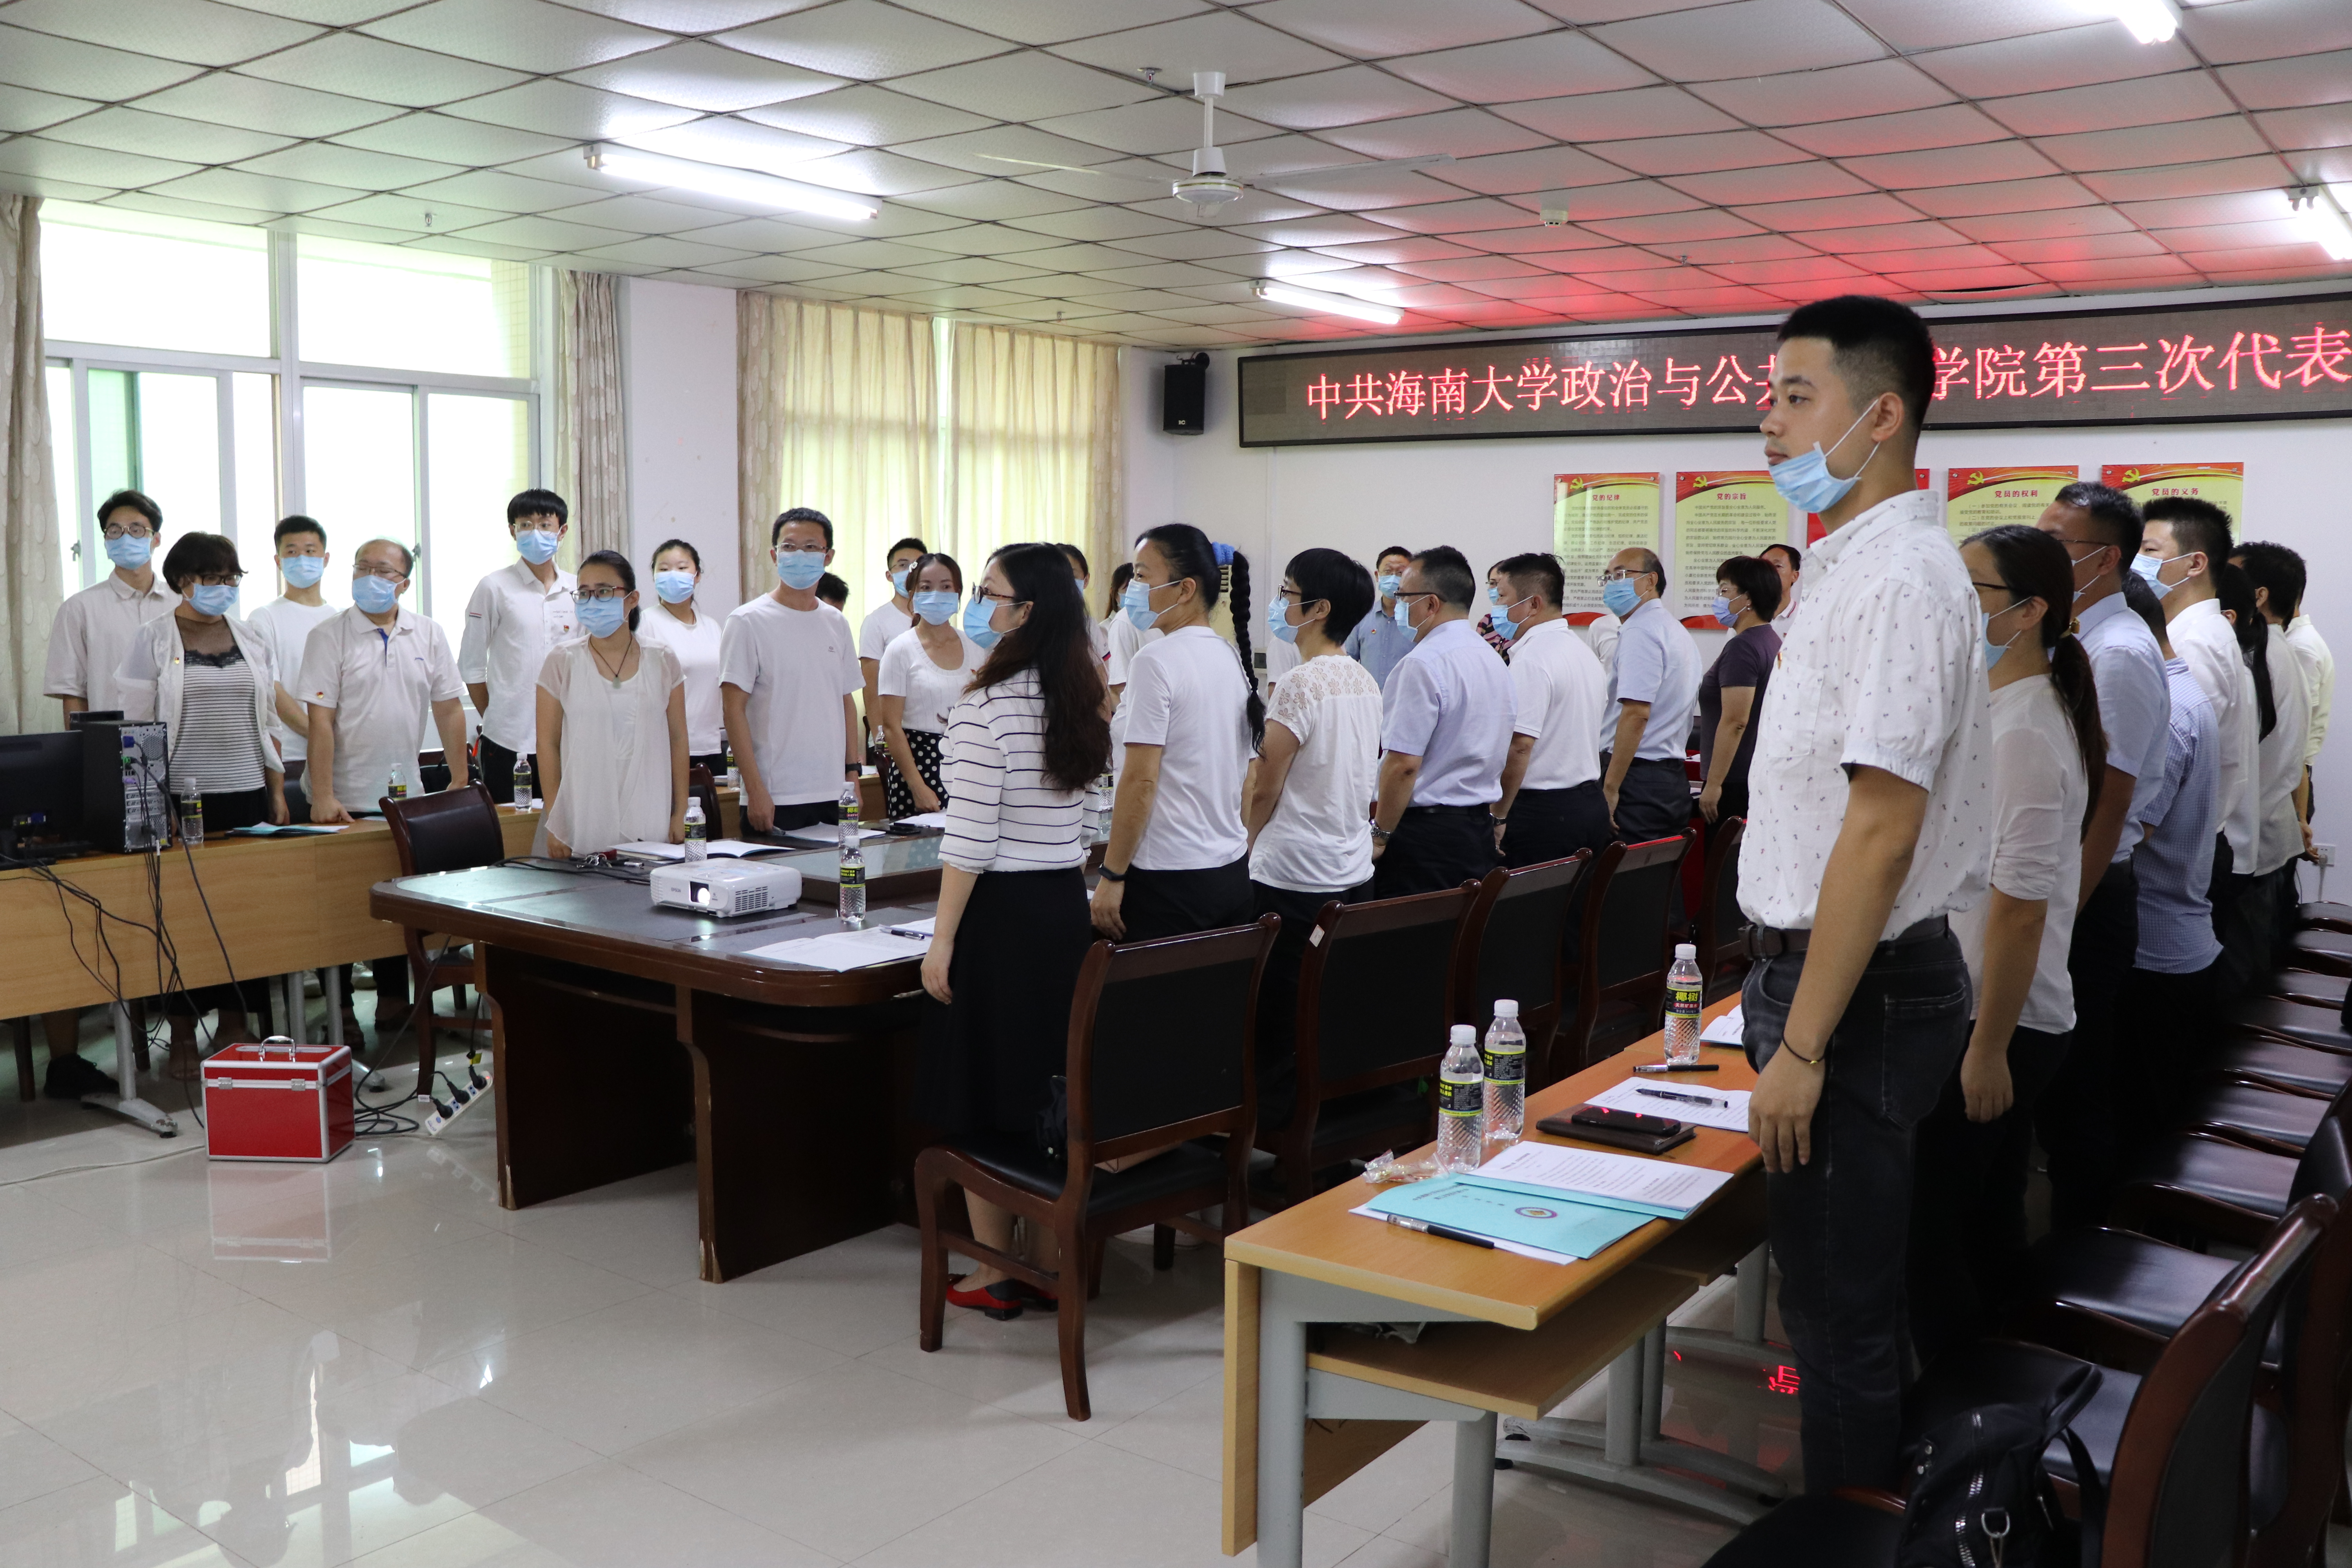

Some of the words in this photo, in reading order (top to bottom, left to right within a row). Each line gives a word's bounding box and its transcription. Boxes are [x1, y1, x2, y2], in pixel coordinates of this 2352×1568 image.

[1994, 490, 2038, 498] 党员的权利
[2152, 488, 2199, 496] 党员的义务
[1675, 991, 1698, 1002] 椰树
